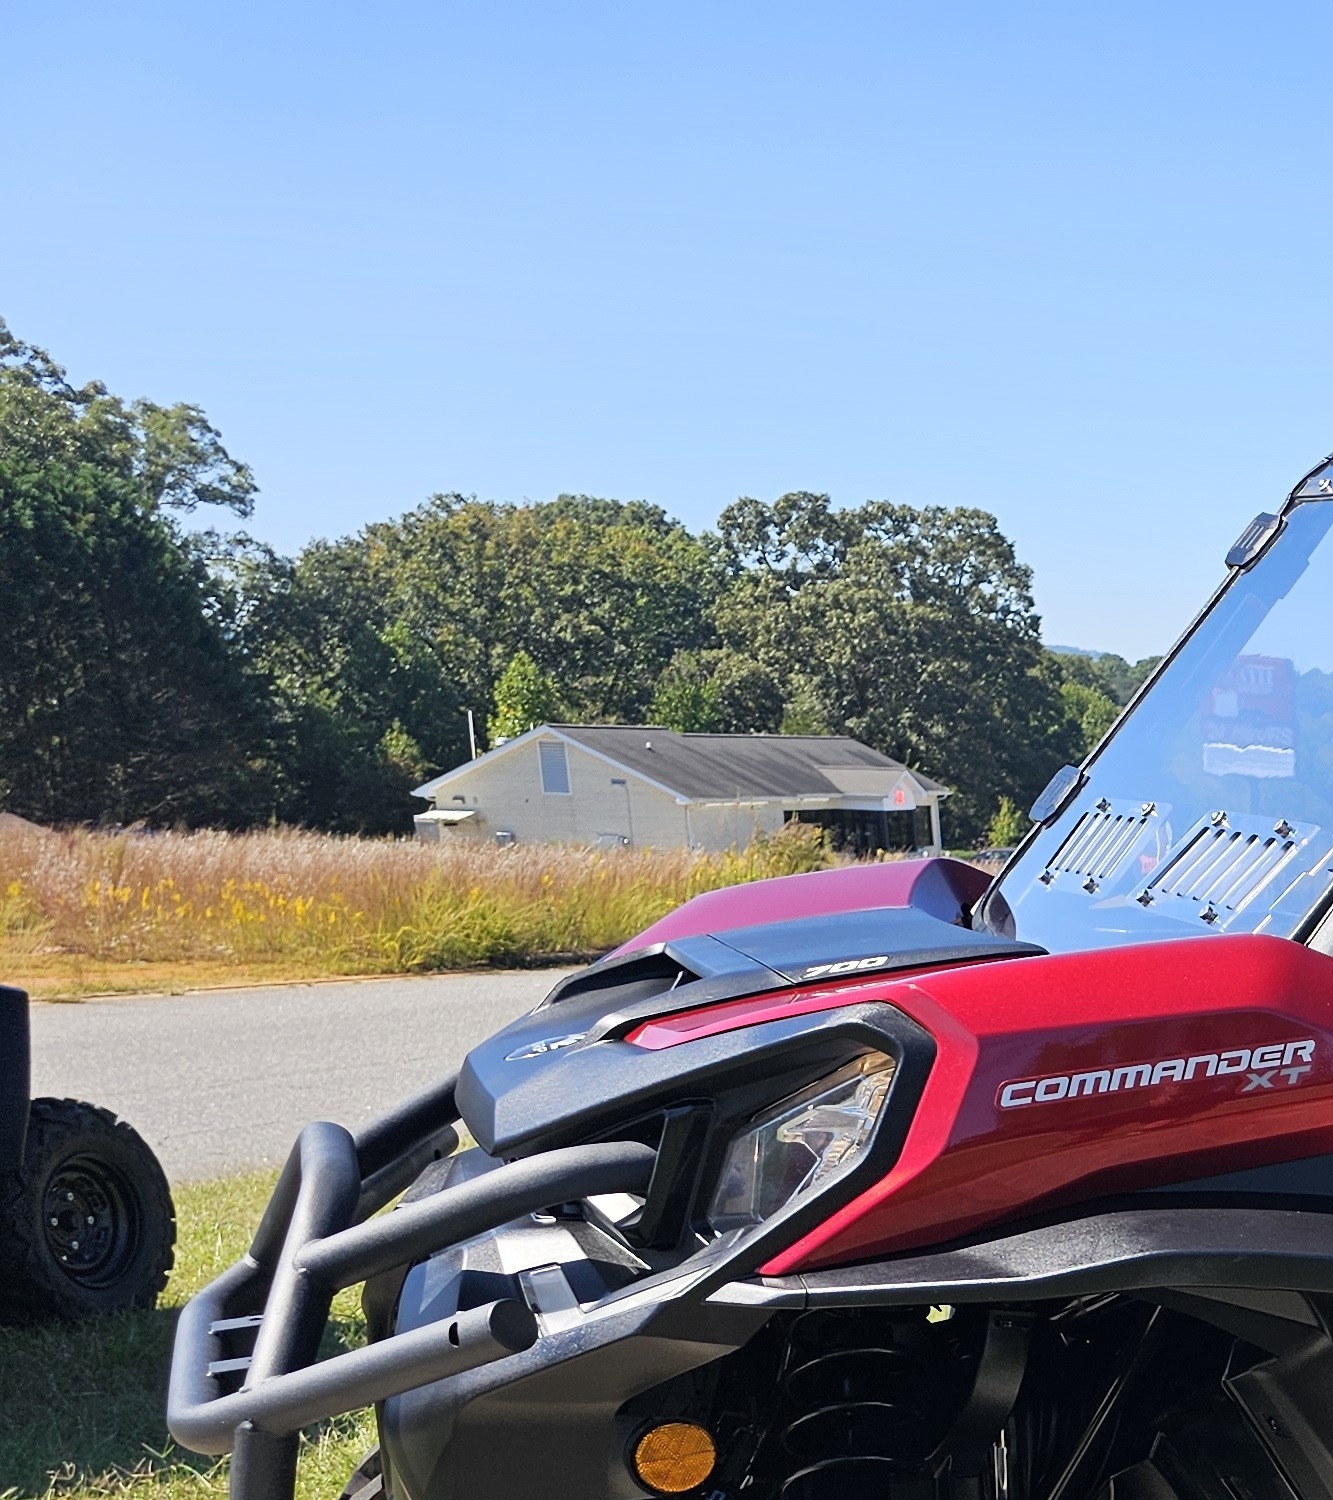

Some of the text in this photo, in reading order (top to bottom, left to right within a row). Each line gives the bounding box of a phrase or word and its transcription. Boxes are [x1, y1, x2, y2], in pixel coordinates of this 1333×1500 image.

[803, 955, 890, 979] 700
[1000, 1040, 1315, 1107] COMMANDER
[1241, 1064, 1311, 1092] XT
